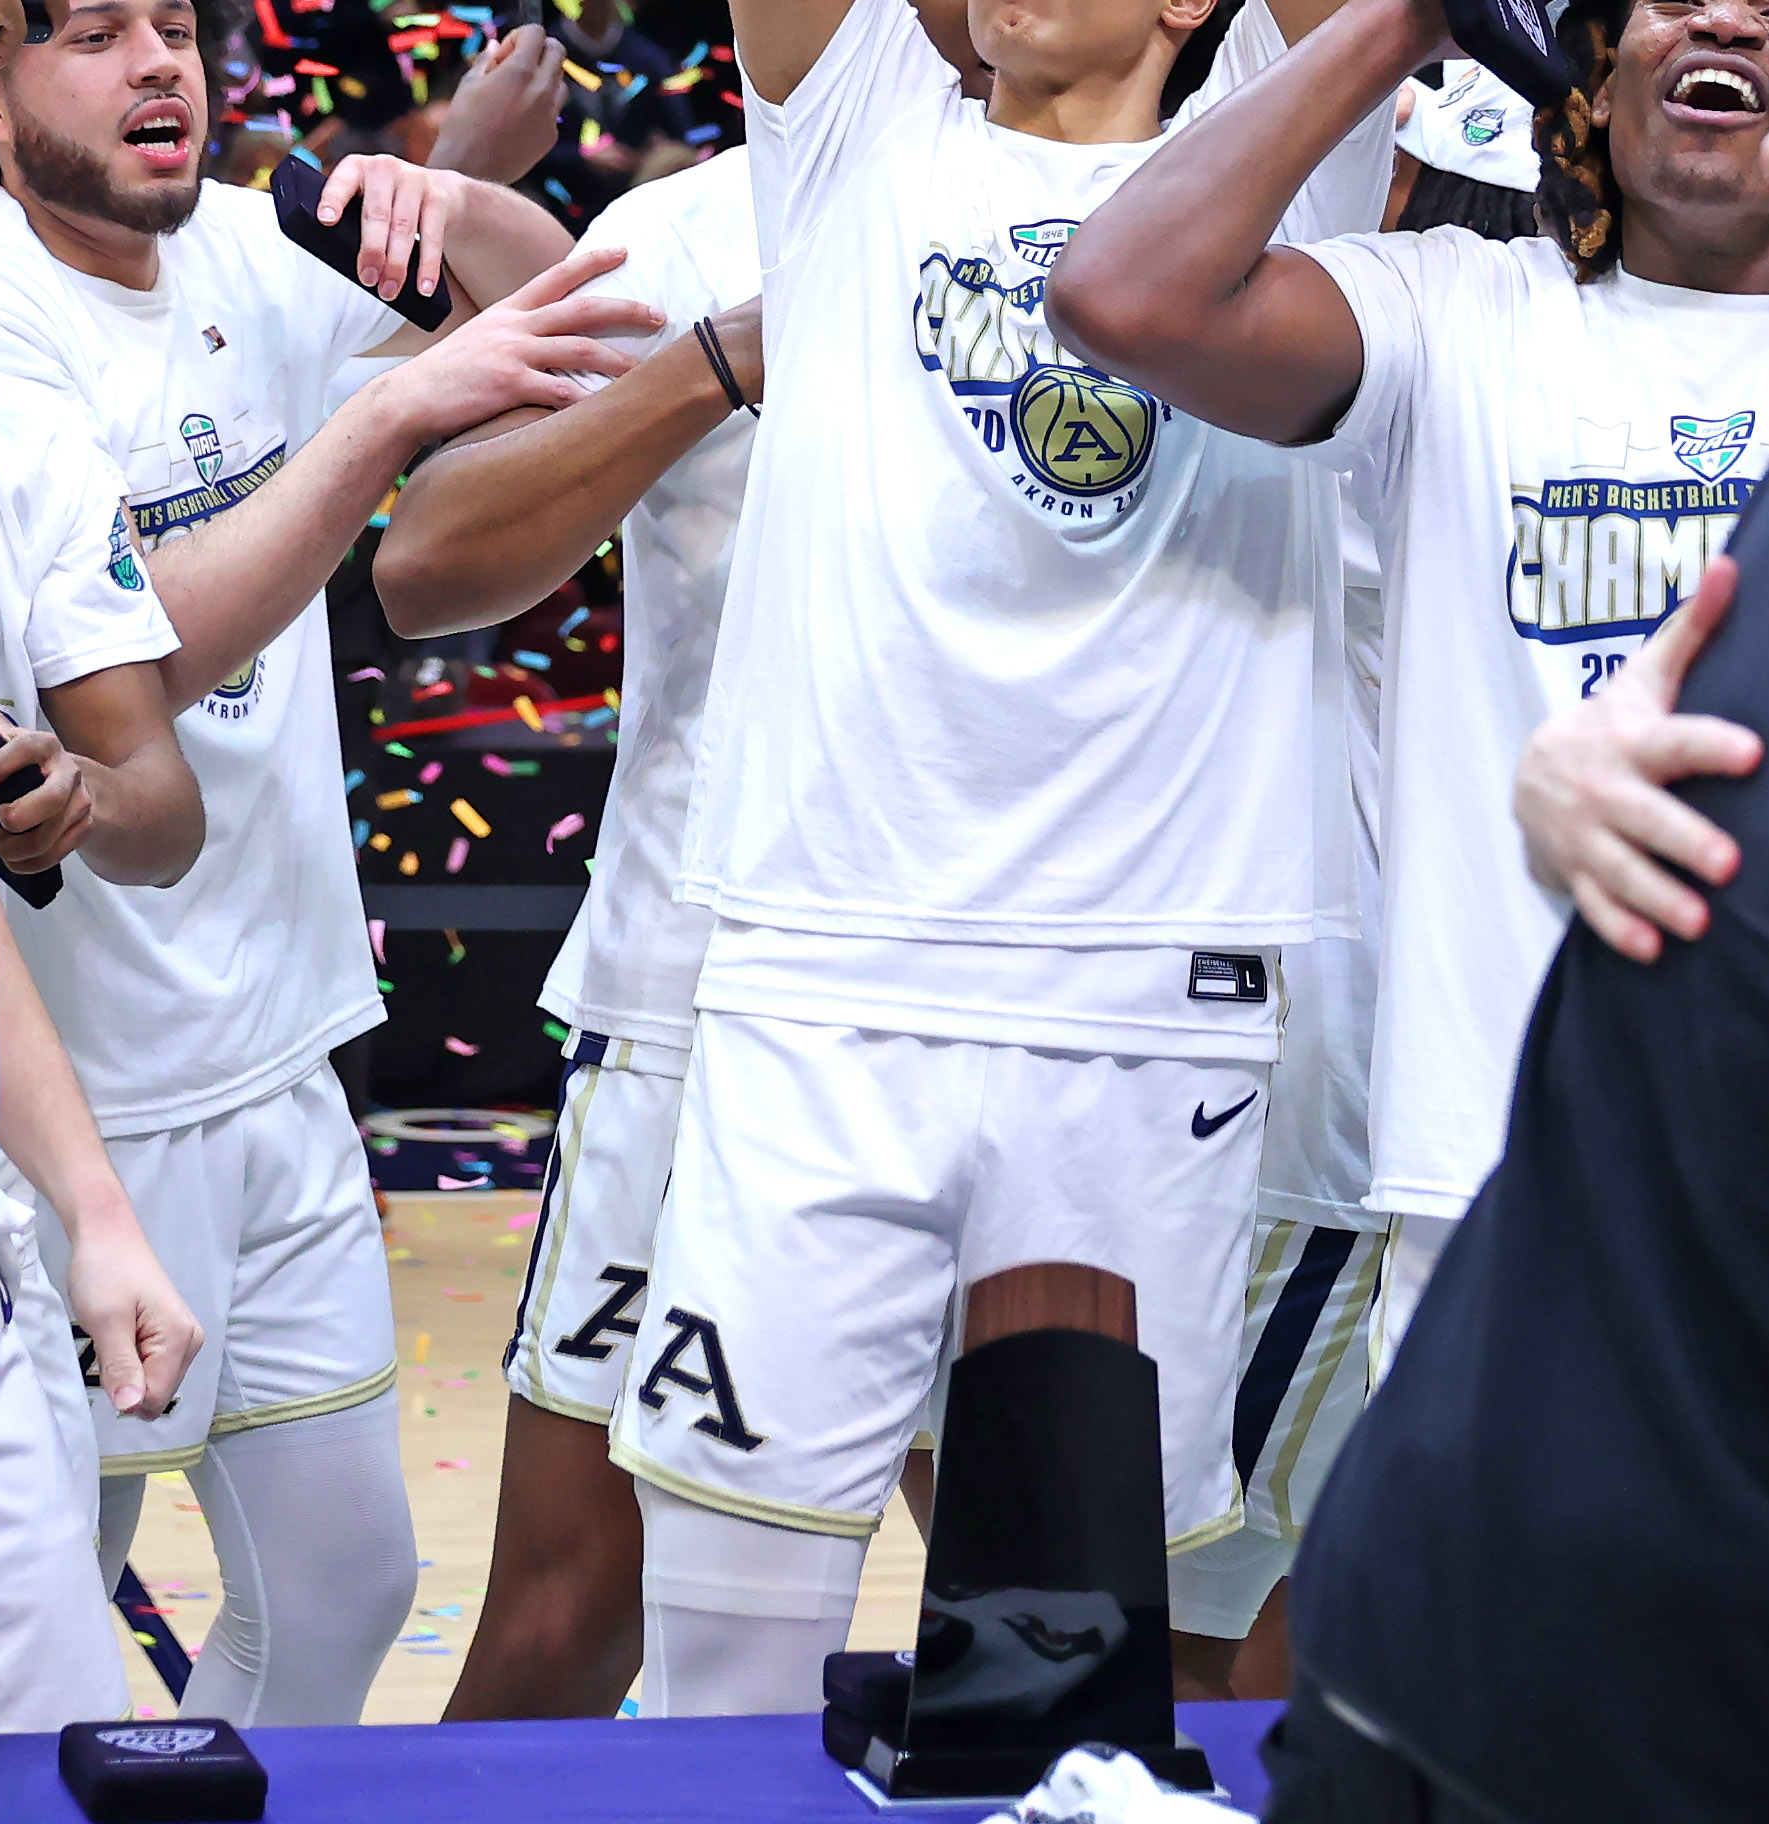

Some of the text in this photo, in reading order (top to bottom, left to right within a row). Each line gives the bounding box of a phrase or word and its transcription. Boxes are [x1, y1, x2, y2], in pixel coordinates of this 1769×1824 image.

[187, 434, 220, 459] MAC
[1051, 420, 1124, 463] A
[1673, 423, 1750, 456] MAC
[166, 484, 232, 523] BASKETBALL
[1011, 473, 1094, 519] AKRON
[1547, 482, 1599, 509] MEN'S
[1607, 482, 1739, 511] BASKETBALL
[638, 1302, 773, 1454] A
